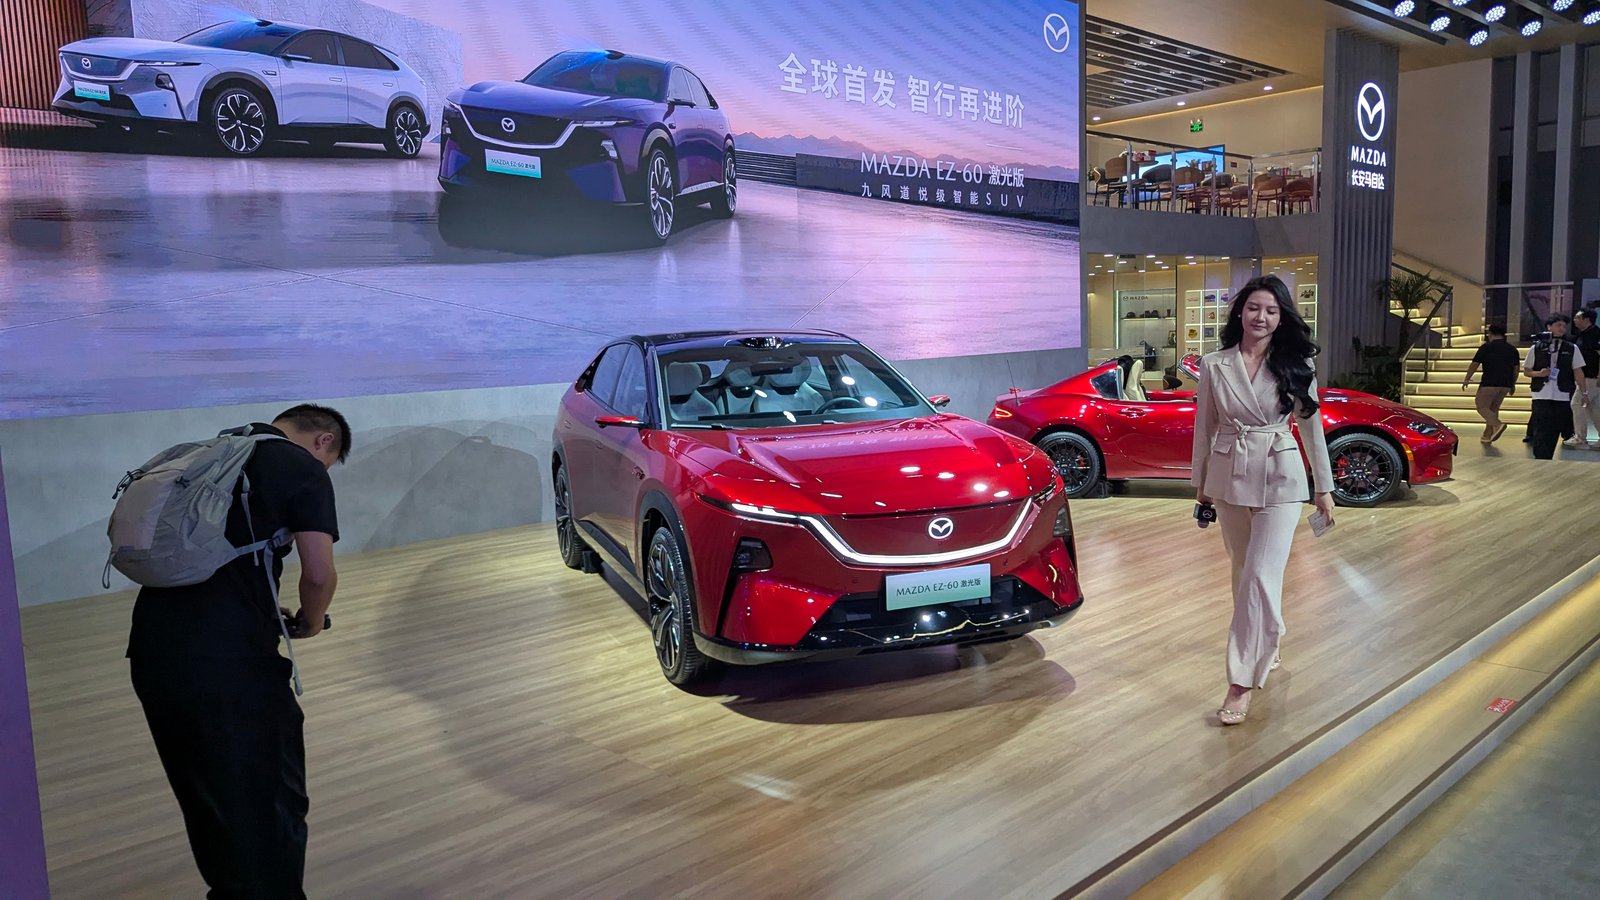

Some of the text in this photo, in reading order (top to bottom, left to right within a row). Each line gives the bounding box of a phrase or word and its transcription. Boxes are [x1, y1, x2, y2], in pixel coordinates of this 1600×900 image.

[778, 52, 1025, 129] 全球首发 智行再进阶
[1351, 145, 1387, 167] MAZDA
[860, 152, 1025, 188] MAZDA EZ-60 激光版
[1351, 168, 1385, 190] 长安马自达
[896, 578, 981, 596] MAZDA EZ-60 激光版
